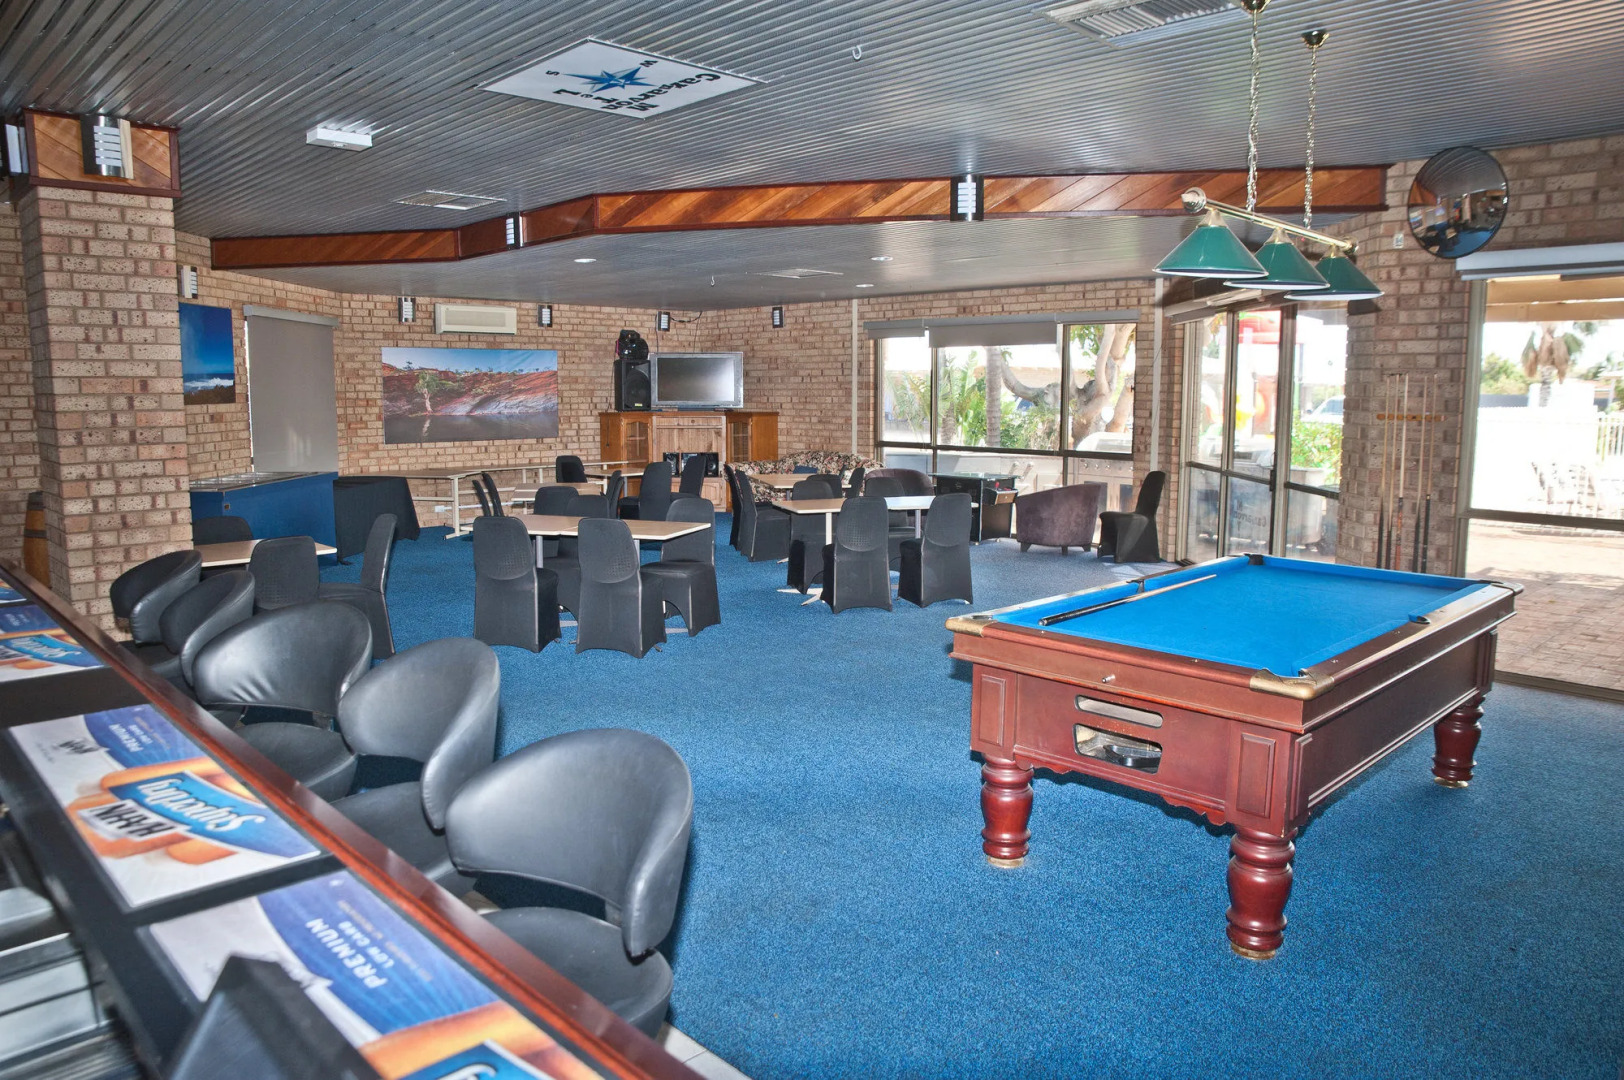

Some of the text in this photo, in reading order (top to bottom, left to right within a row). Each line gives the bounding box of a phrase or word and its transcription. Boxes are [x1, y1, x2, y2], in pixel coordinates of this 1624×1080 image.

[600, 73, 721, 110] Carnarvon
[94, 803, 176, 838] HAHN
[305, 918, 388, 988] PREMIUM
[366, 946, 395, 968] LOW
